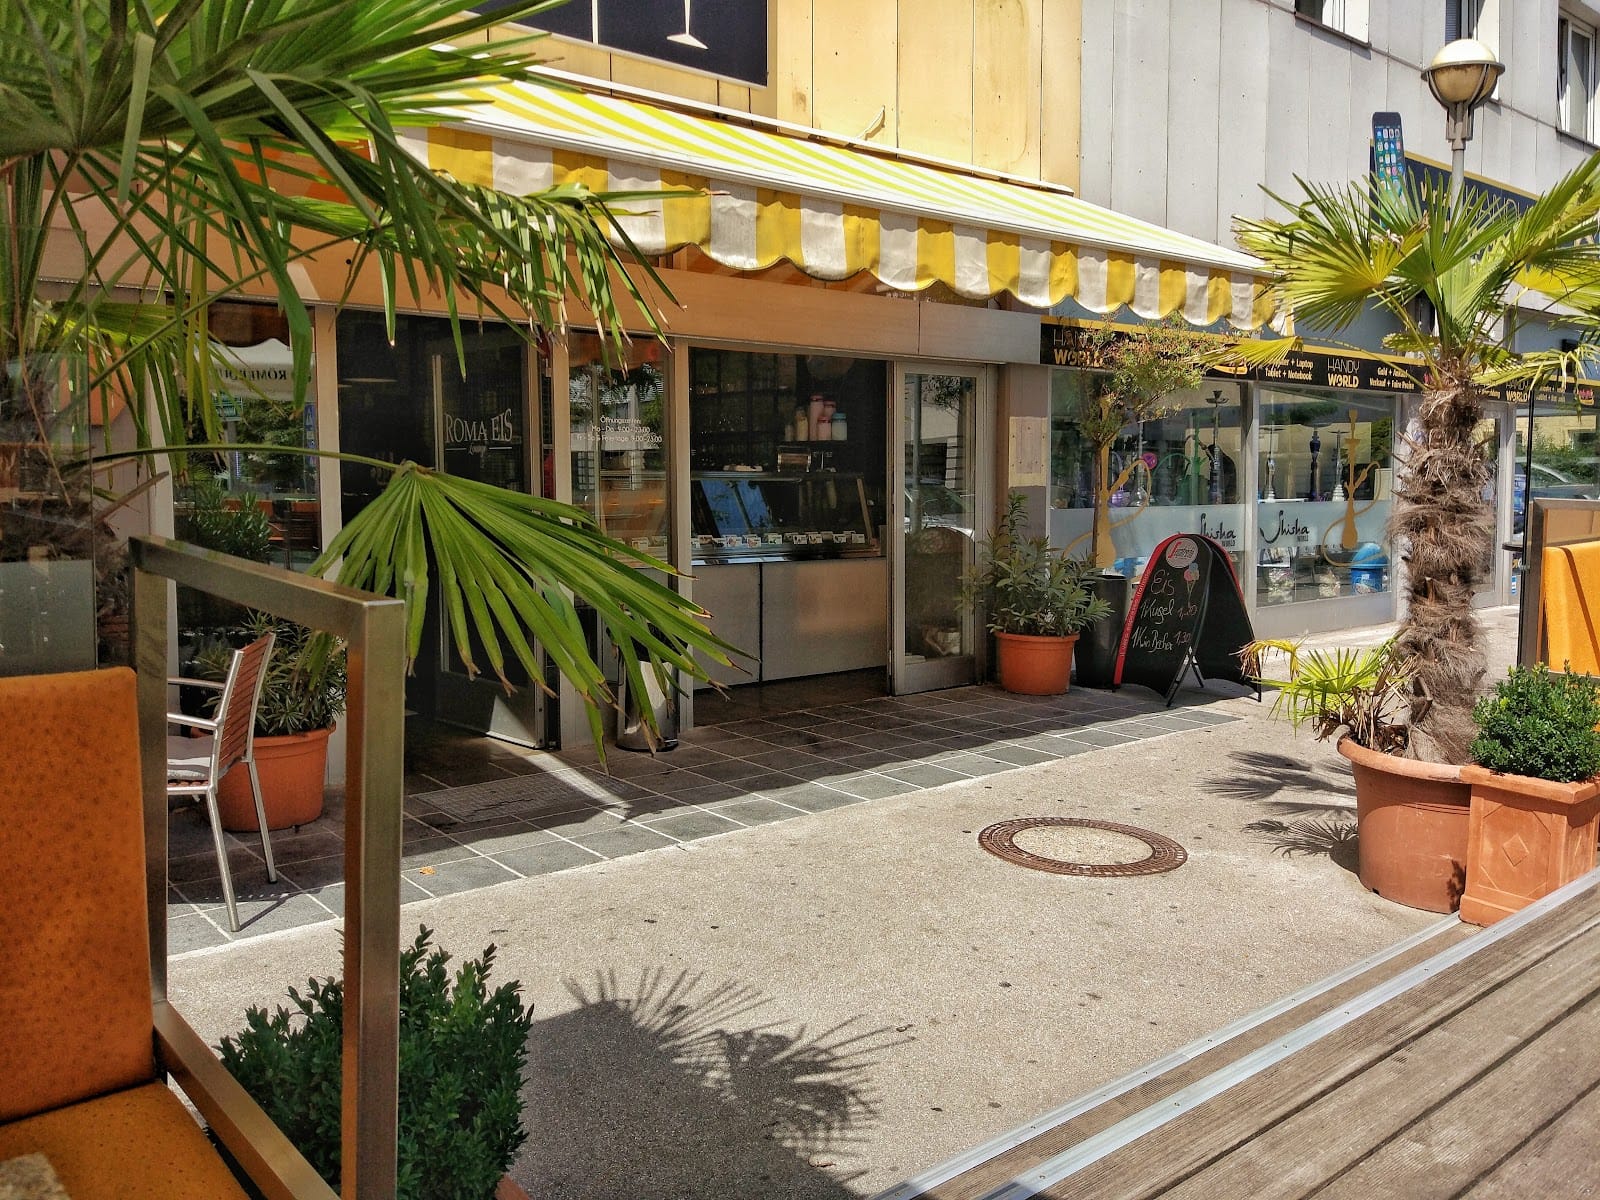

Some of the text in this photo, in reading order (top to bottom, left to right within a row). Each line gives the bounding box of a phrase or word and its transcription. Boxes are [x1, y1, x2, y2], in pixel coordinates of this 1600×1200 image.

[1296, 358, 1314, 371] Laptop
[1327, 357, 1360, 374] HANDY
[1287, 370, 1313, 380] Notebook
[1328, 373, 1360, 388] WORLD
[444, 408, 513, 443] ROMA EIS
[1260, 510, 1310, 544] Shisha
[1150, 569, 1175, 596] Eis
